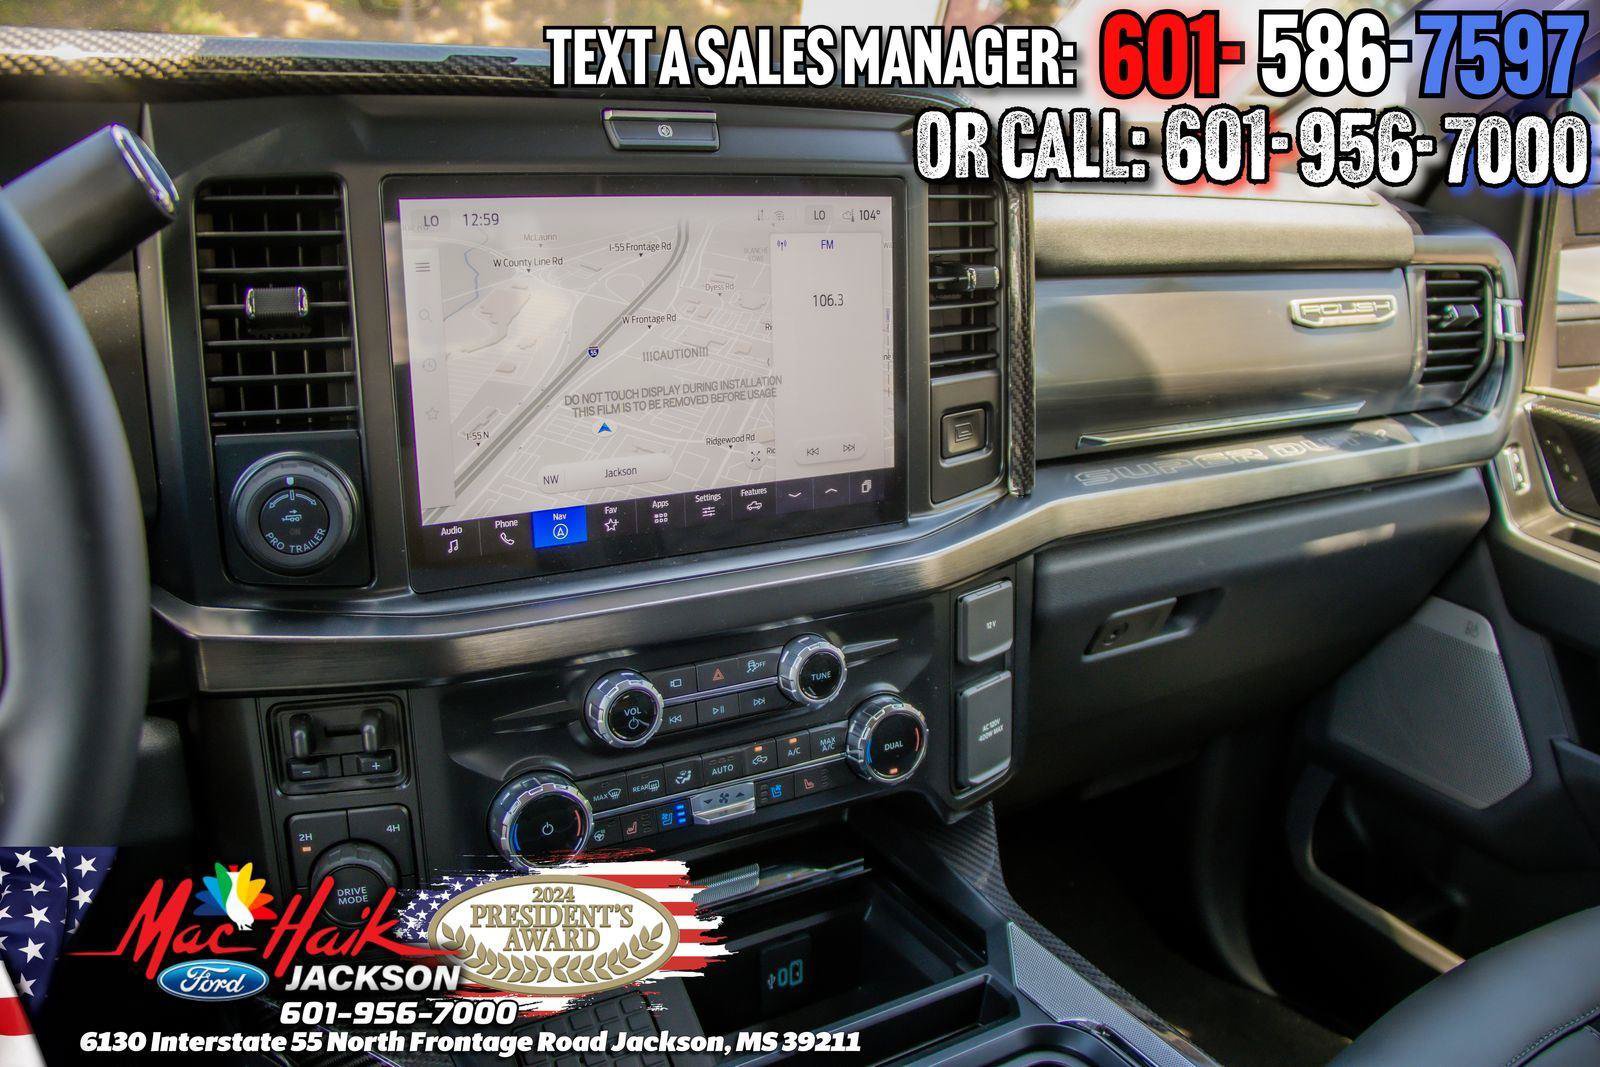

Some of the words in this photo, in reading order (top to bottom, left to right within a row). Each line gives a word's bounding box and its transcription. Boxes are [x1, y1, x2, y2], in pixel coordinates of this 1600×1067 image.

[423, 215, 439, 227] LO
[462, 212, 499, 227] 12:59
[814, 210, 826, 221] LO
[626, 243, 660, 253] Frontage
[661, 242, 672, 250] Rd
[820, 239, 835, 250] FM
[493, 259, 502, 267] W
[503, 258, 532, 269] County
[534, 257, 551, 266] Line
[552, 256, 563, 265] Rd
[705, 282, 725, 293] Dyess
[725, 282, 735, 290] Rd
[812, 293, 844, 307] 106.3
[622, 316, 630, 324] W
[632, 315, 665, 325] Frontage
[666, 314, 677, 322] Rd
[564, 394, 580, 406] DO
[581, 393, 603, 405] NOT
[604, 389, 639, 403] TOUCH
[641, 385, 680, 399] DISPLAY
[682, 382, 718, 396] DURING
[719, 375, 783, 391] INSTALLATION
[572, 405, 595, 418] THIS
[596, 404, 621, 416] FILM
[622, 403, 632, 414] IS
[633, 401, 646, 412] TO
[648, 399, 661, 410] BE
[663, 395, 710, 409] REMOVED
[711, 391, 746, 404] BEFORE
[747, 388, 777, 400] USAGE
[466, 432, 482, 441] I-55
[483, 431, 490, 440] N
[705, 434, 743, 446] Ridgewood
[744, 433, 755, 443] Rd
[1075, 448, 1267, 486] SUPER
[542, 474, 560, 486] NW
[604, 466, 637, 479] Jackson
[740, 486, 768, 497] Features
[695, 492, 722, 503] Settings
[604, 505, 618, 515] Fav
[652, 499, 670, 510] Apps
[553, 512, 567, 522] Nav
[495, 518, 519, 529] Phone
[441, 525, 463, 536] Audio
[265, 532, 285, 550] PRO
[289, 527, 327, 554] TRAILER
[811, 671, 832, 682] TUNE
[623, 707, 642, 717] VOL
[994, 723, 1004, 736] MAX
[820, 736, 836, 747] MAX
[884, 740, 904, 751] DUAL
[787, 747, 801, 757] A/C
[821, 743, 836, 752] A/C
[711, 763, 735, 776] AUTO
[632, 783, 650, 793] REAR
[592, 792, 609, 803] MAX
[386, 824, 401, 833] 4H
[299, 832, 313, 842] 2H
[337, 886, 368, 897] DRIVE
[338, 894, 369, 905] MODE
